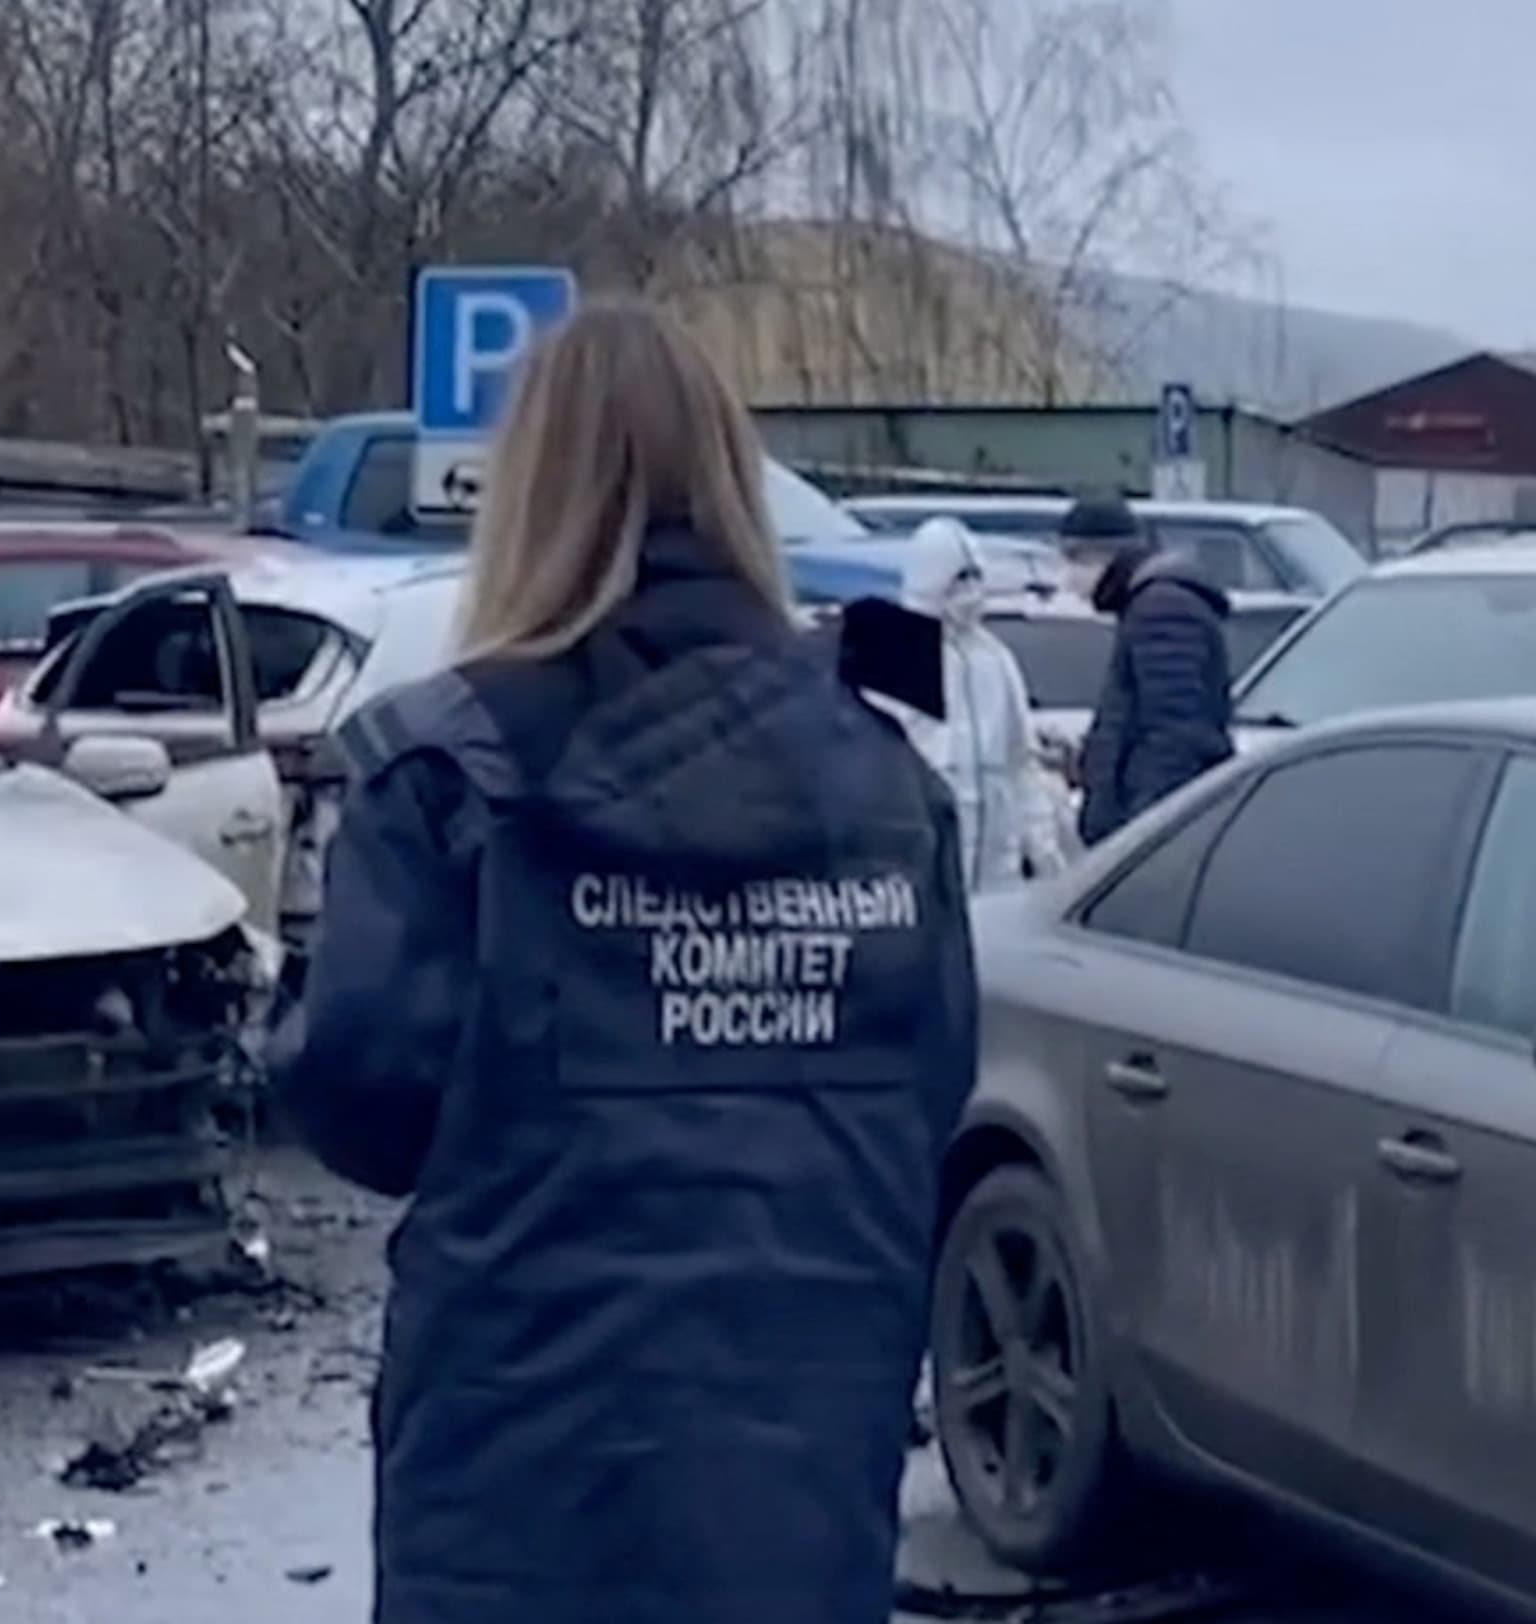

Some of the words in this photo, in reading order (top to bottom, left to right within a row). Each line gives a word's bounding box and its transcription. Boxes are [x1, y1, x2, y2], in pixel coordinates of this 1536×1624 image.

[453, 293, 530, 414] P
[1167, 390, 1187, 453] P
[651, 932, 853, 986] КОМИТЕТ
[663, 991, 835, 1045] РОССИИ
